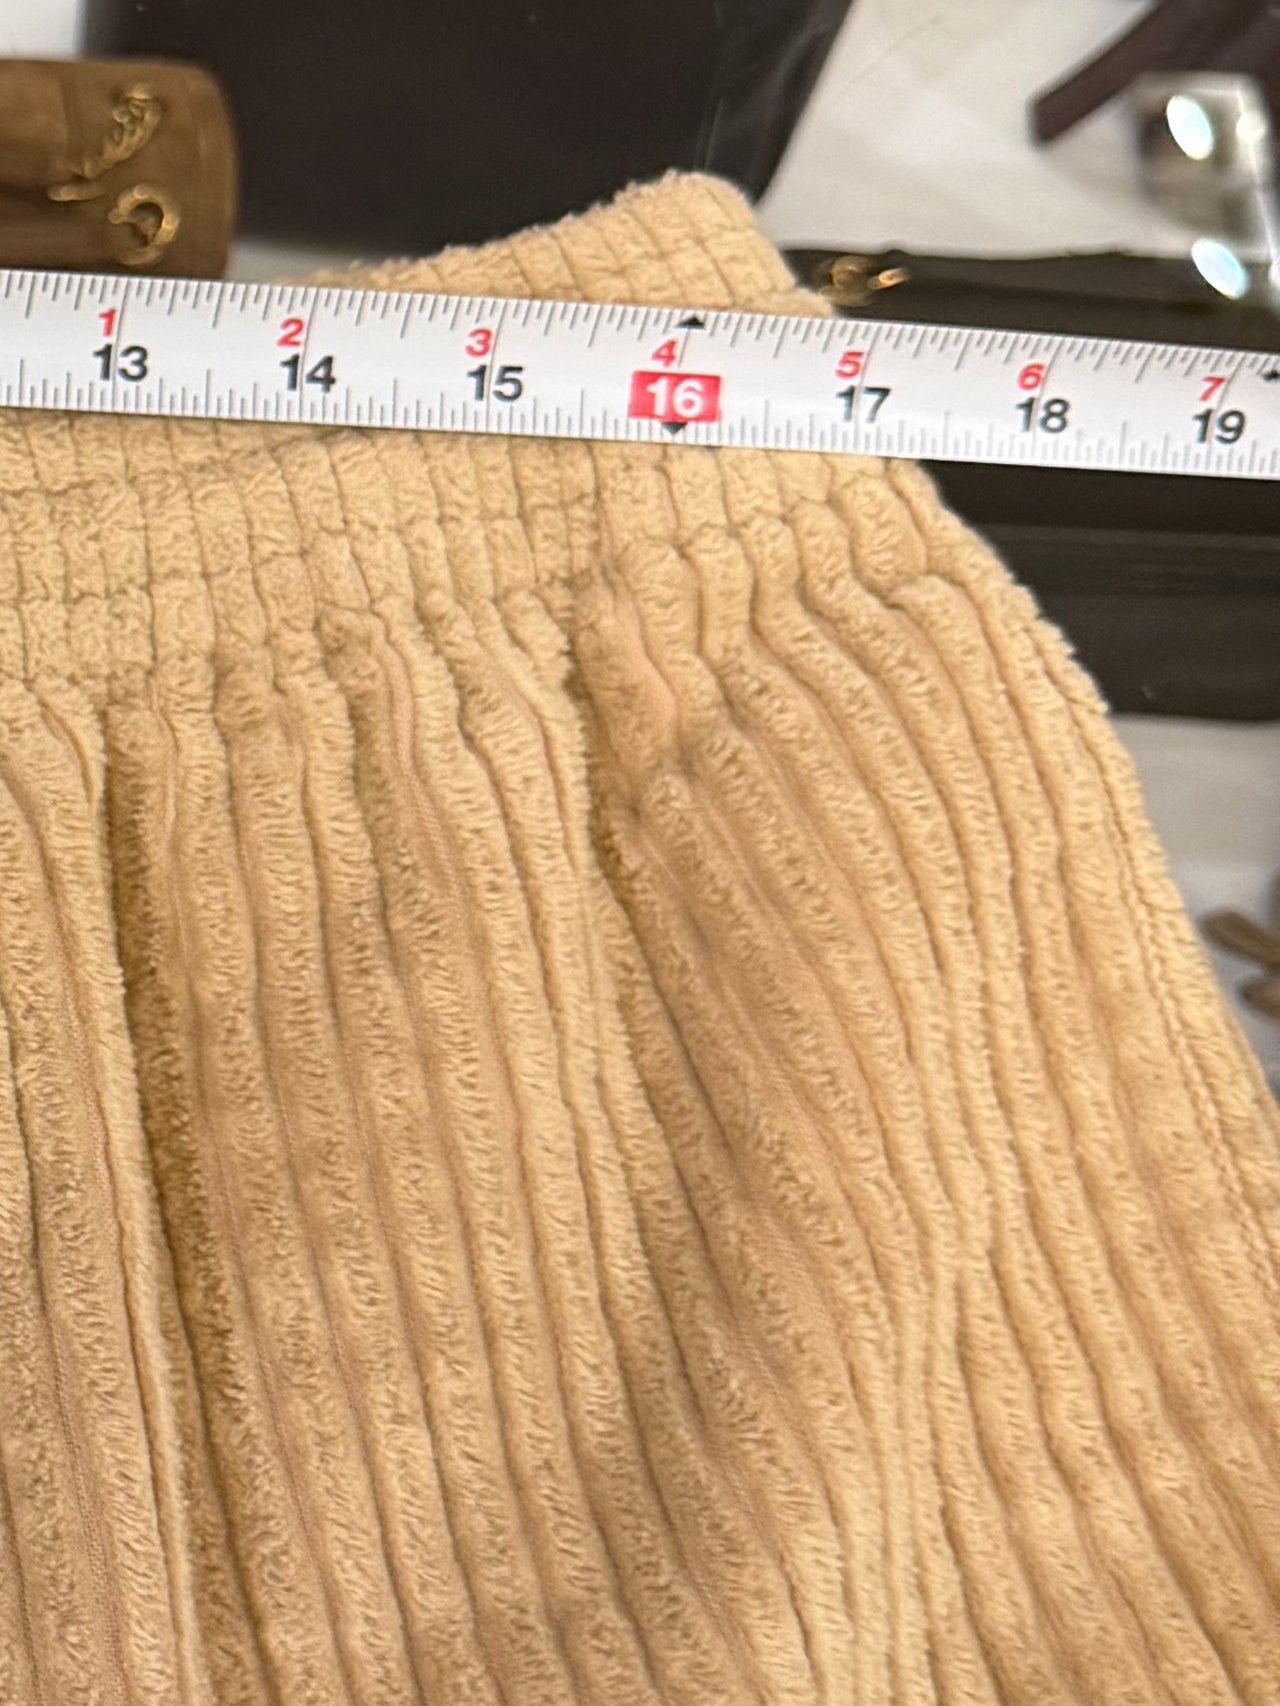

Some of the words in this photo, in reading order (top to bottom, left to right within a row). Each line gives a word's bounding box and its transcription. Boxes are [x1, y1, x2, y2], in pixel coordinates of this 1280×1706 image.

[99, 308, 117, 337] 1
[278, 318, 304, 347] 2
[465, 328, 493, 357] 3
[651, 339, 678, 367] 4
[93, 344, 148, 382] 13
[279, 354, 336, 393] 14
[835, 350, 865, 379] 5
[1017, 363, 1046, 391] 6
[467, 364, 524, 402] 15
[646, 378, 702, 417] 16
[1200, 377, 1226, 401] 7
[836, 385, 892, 423] 17
[1016, 397, 1070, 433] 18
[1192, 409, 1246, 445] 19
